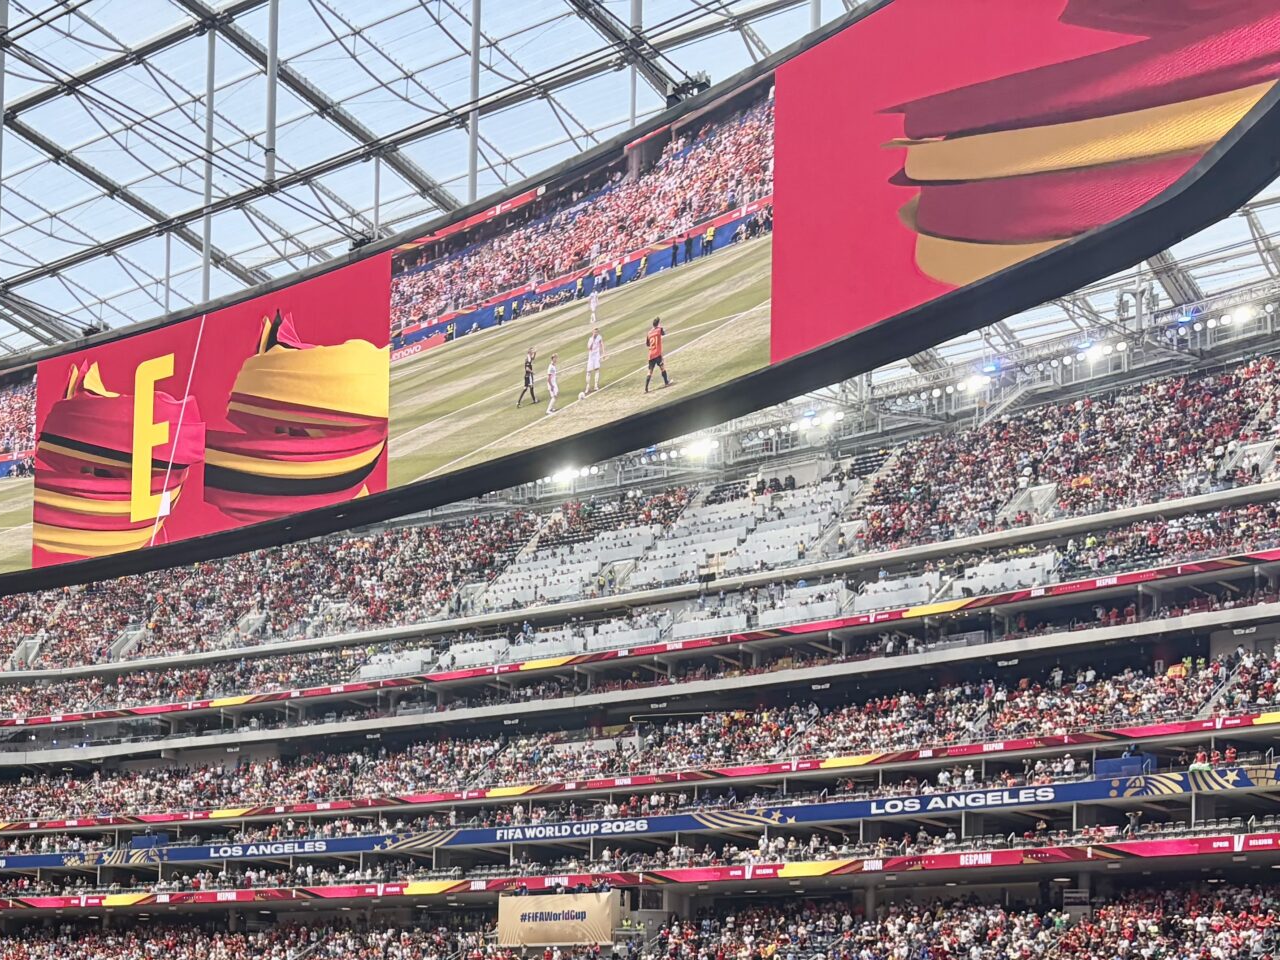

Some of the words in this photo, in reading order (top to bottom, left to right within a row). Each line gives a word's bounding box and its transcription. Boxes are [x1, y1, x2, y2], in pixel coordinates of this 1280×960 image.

[871, 799, 921, 815] LOS
[926, 787, 1055, 810] ANGELES
[496, 829, 522, 840] FIFA
[524, 825, 571, 839] WORLD
[573, 824, 598, 836] CUP
[601, 819, 648, 833] 2026
[210, 846, 247, 858] LOS
[249, 841, 327, 856] ANGELES
[520, 910, 587, 923] #FIFAWorldCup
